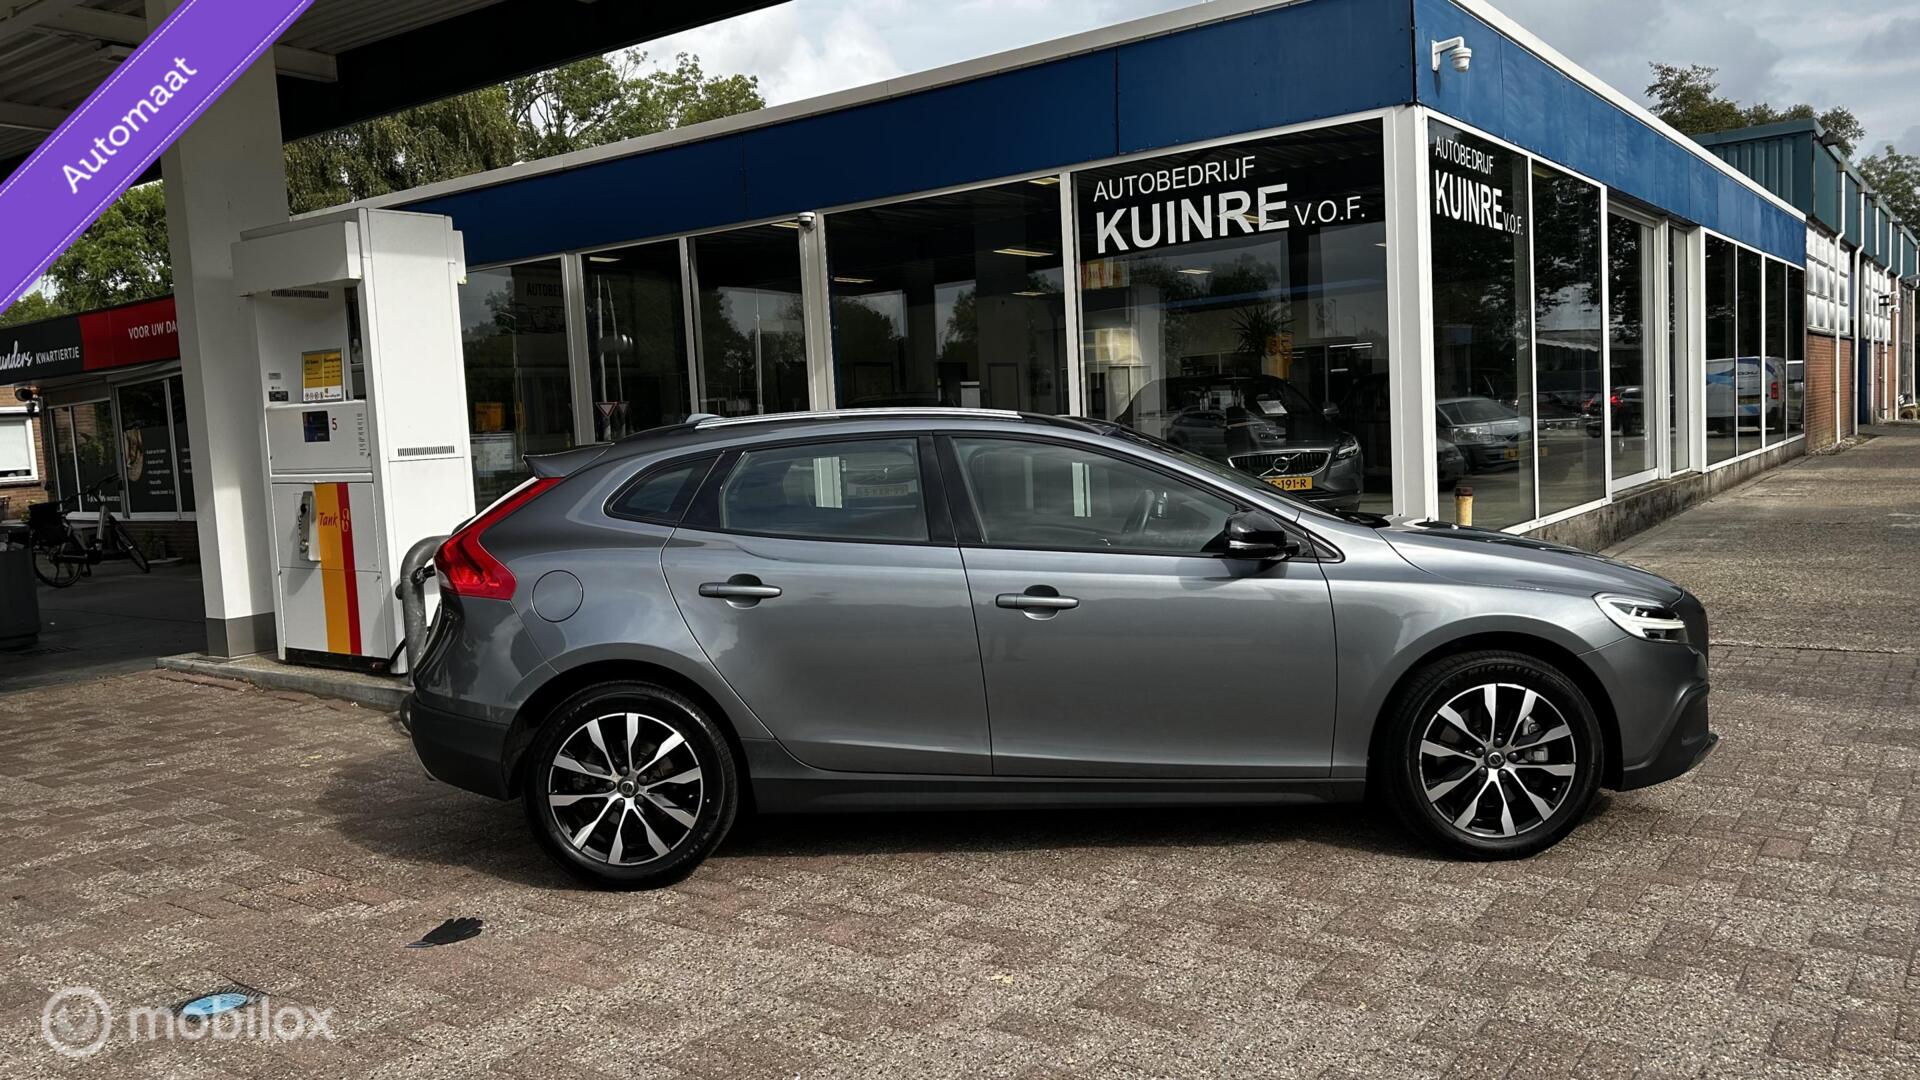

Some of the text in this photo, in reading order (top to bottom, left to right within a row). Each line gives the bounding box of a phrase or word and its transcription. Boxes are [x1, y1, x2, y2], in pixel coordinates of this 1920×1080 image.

[1435, 135, 1494, 175] AUTOBEDRIJF
[1093, 156, 1256, 202] AUTOBEDRIJF
[1435, 169, 1524, 236] KUINRE V.O.F.
[1096, 183, 1366, 254] KUINRE V.O.F.
[128, 325, 150, 340] VOOR
[151, 321, 164, 336] UW
[35, 346, 80, 365] KWARTIERTJE
[331, 417, 338, 431] 5
[319, 511, 338, 528] Tank
